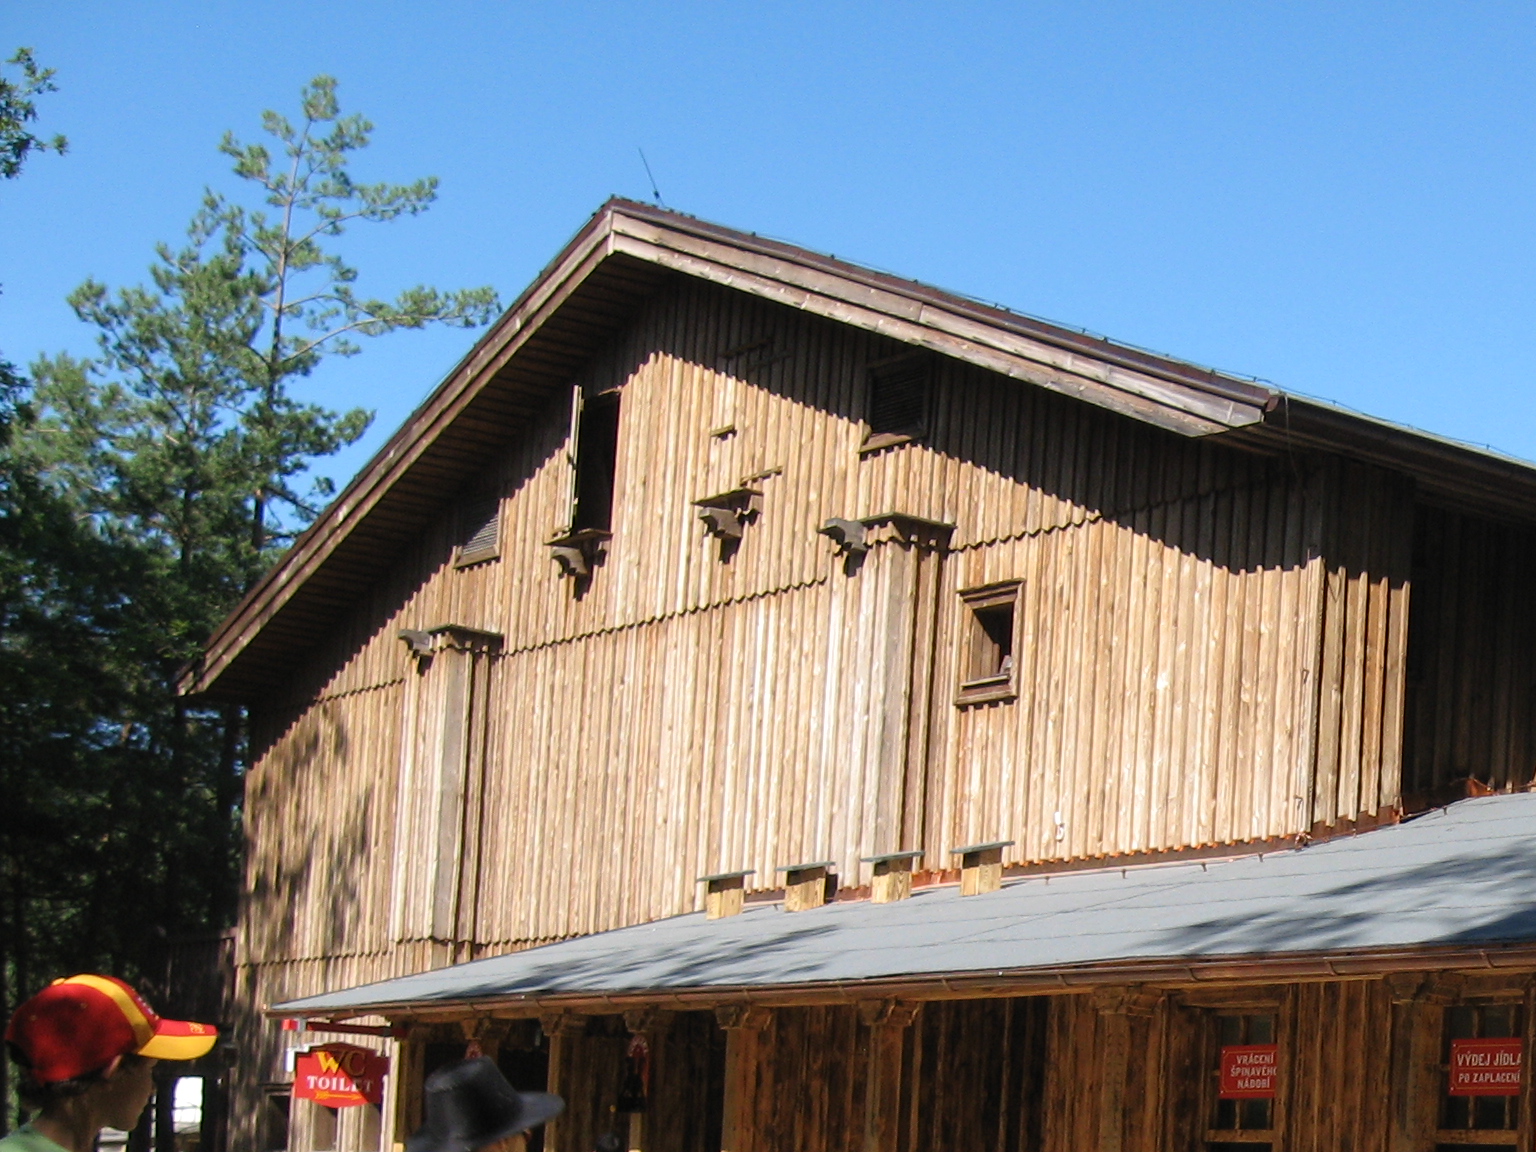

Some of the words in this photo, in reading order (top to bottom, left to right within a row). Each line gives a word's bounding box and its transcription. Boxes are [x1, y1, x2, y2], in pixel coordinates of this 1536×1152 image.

[316, 1050, 366, 1077] WC
[1236, 1053, 1274, 1065] VRÁCENÍ
[1457, 1050, 1490, 1067] VÝDEJ
[1493, 1049, 1522, 1066] JÍDLA
[307, 1075, 374, 1093] TOILET
[1237, 1077, 1270, 1089] NÁDOBÍ
[1458, 1073, 1470, 1083] PO
[1472, 1069, 1520, 1083] ZAPLACENÍ
